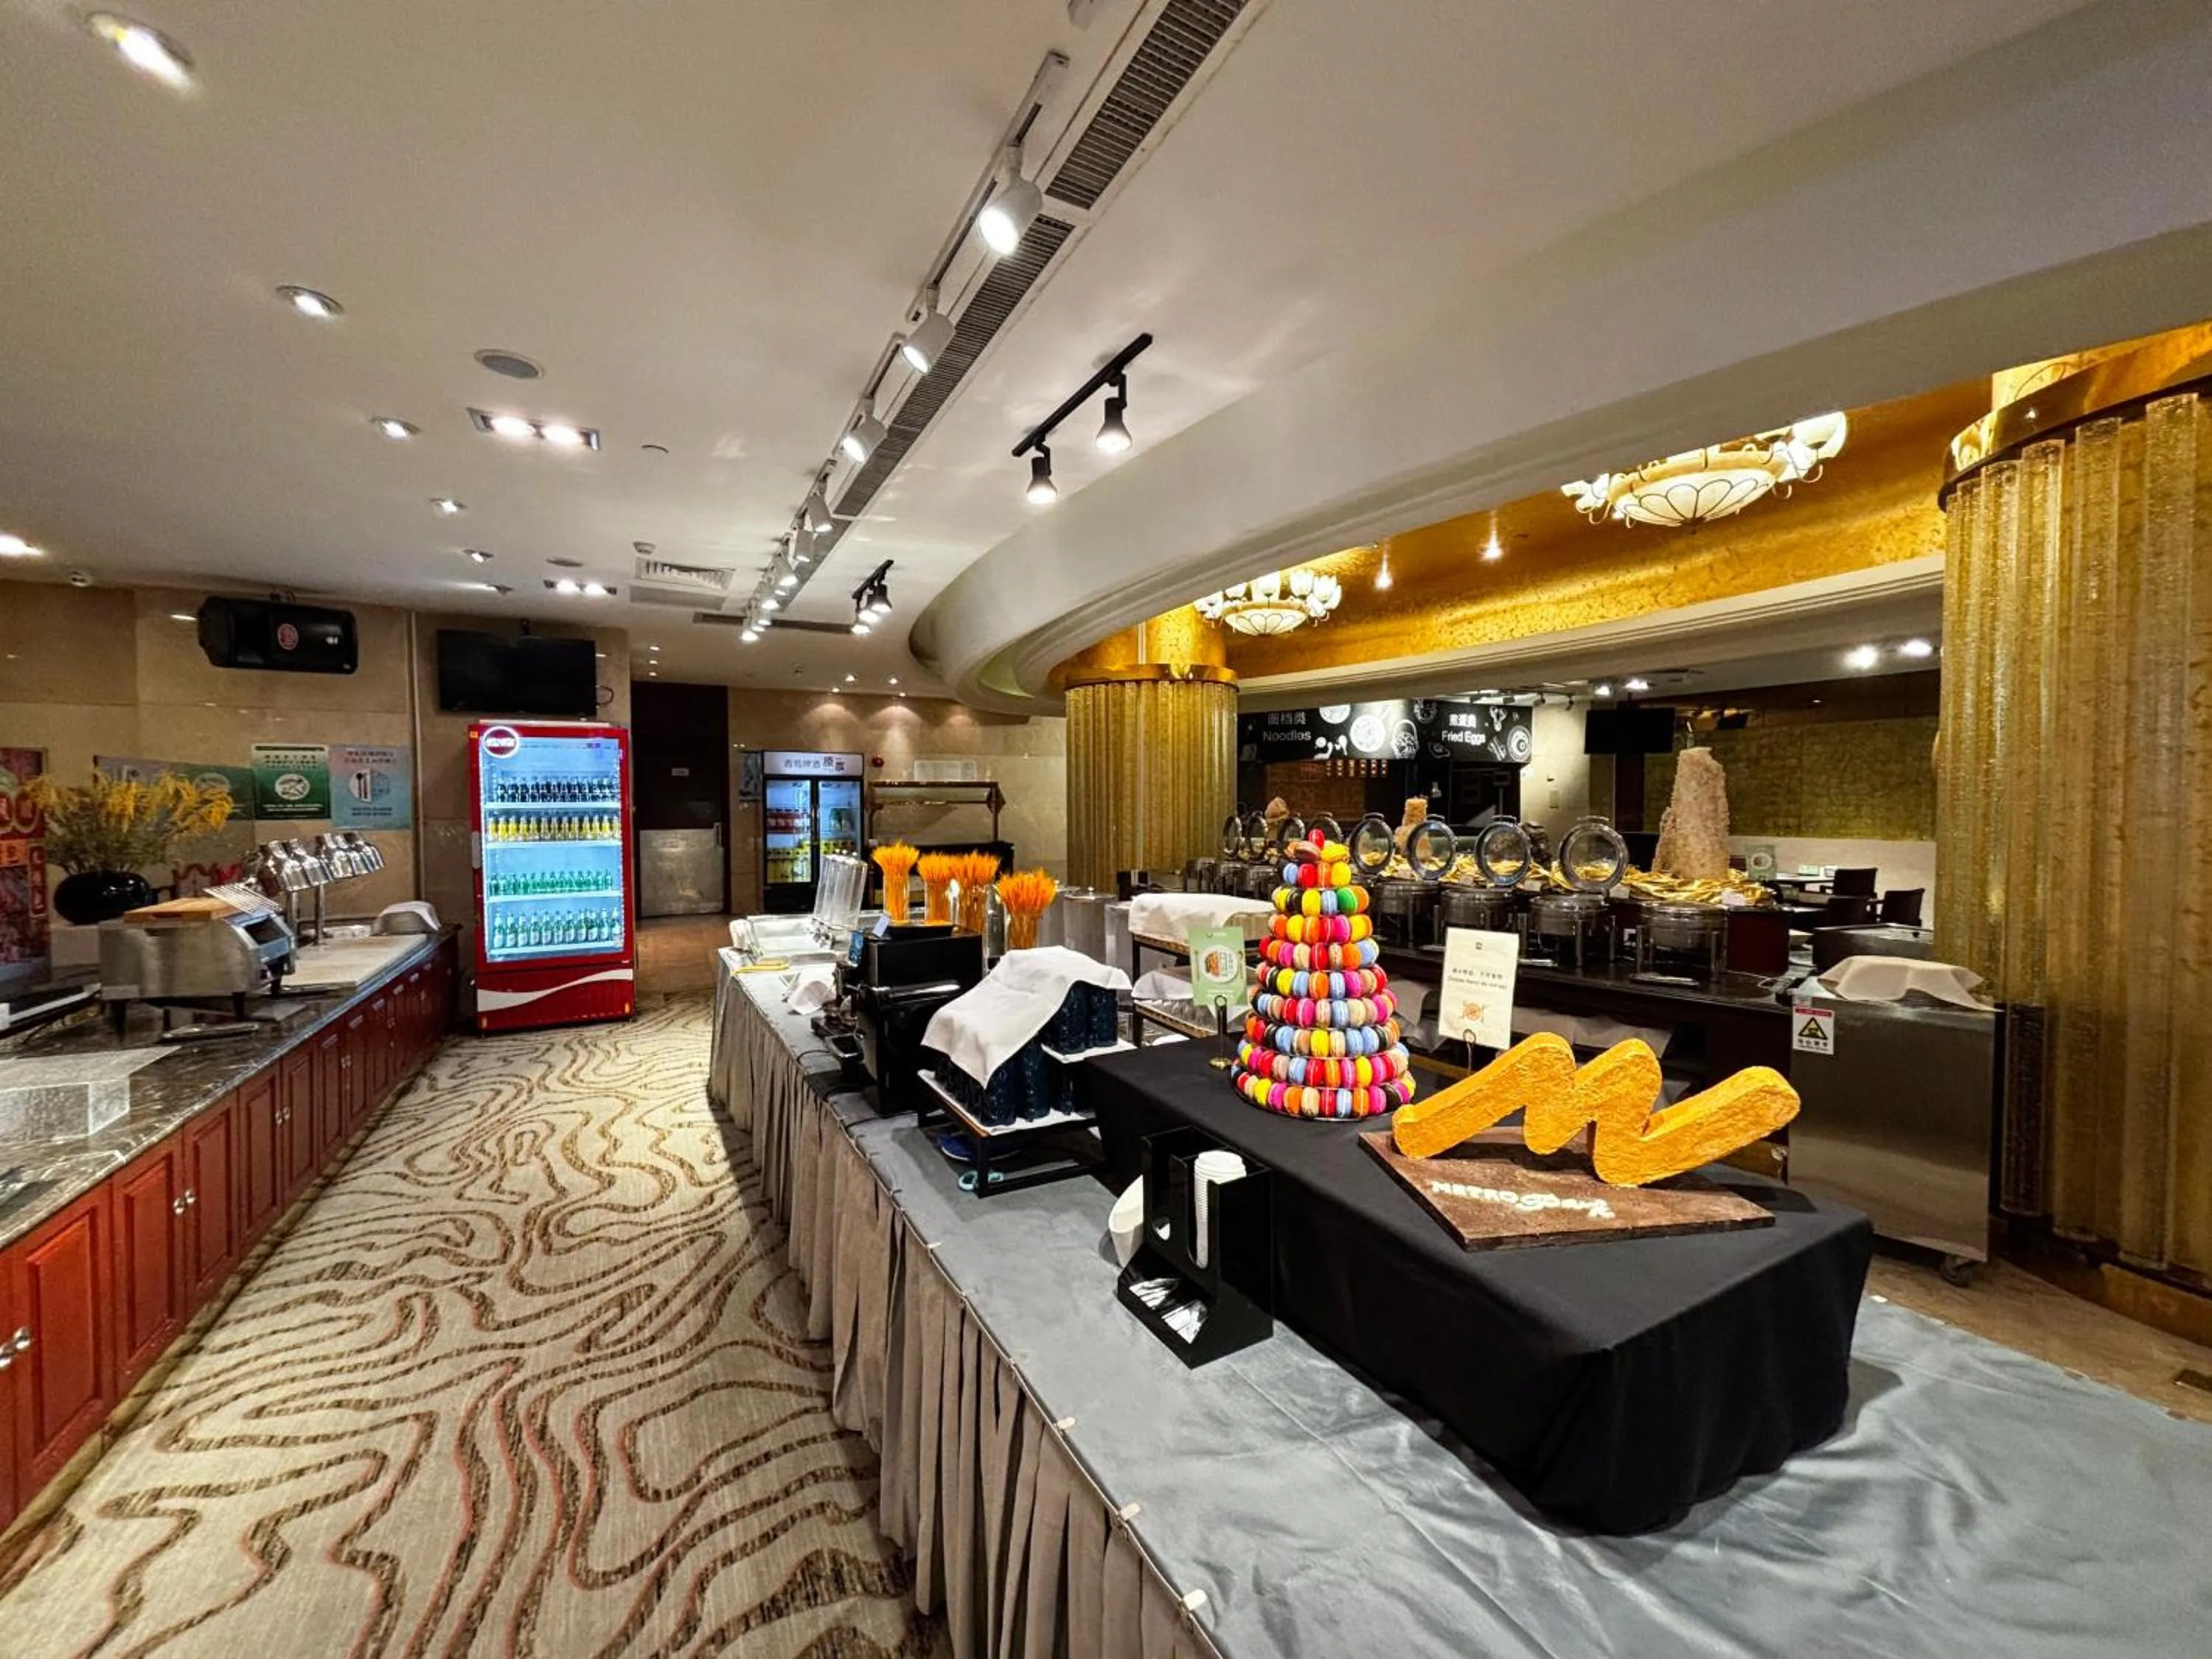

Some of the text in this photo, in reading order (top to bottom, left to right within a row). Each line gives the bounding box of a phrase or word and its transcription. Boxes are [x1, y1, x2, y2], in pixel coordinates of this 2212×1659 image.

[1262, 729, 1312, 742] Noodles
[1441, 730, 1486, 746] Fried Eggs
